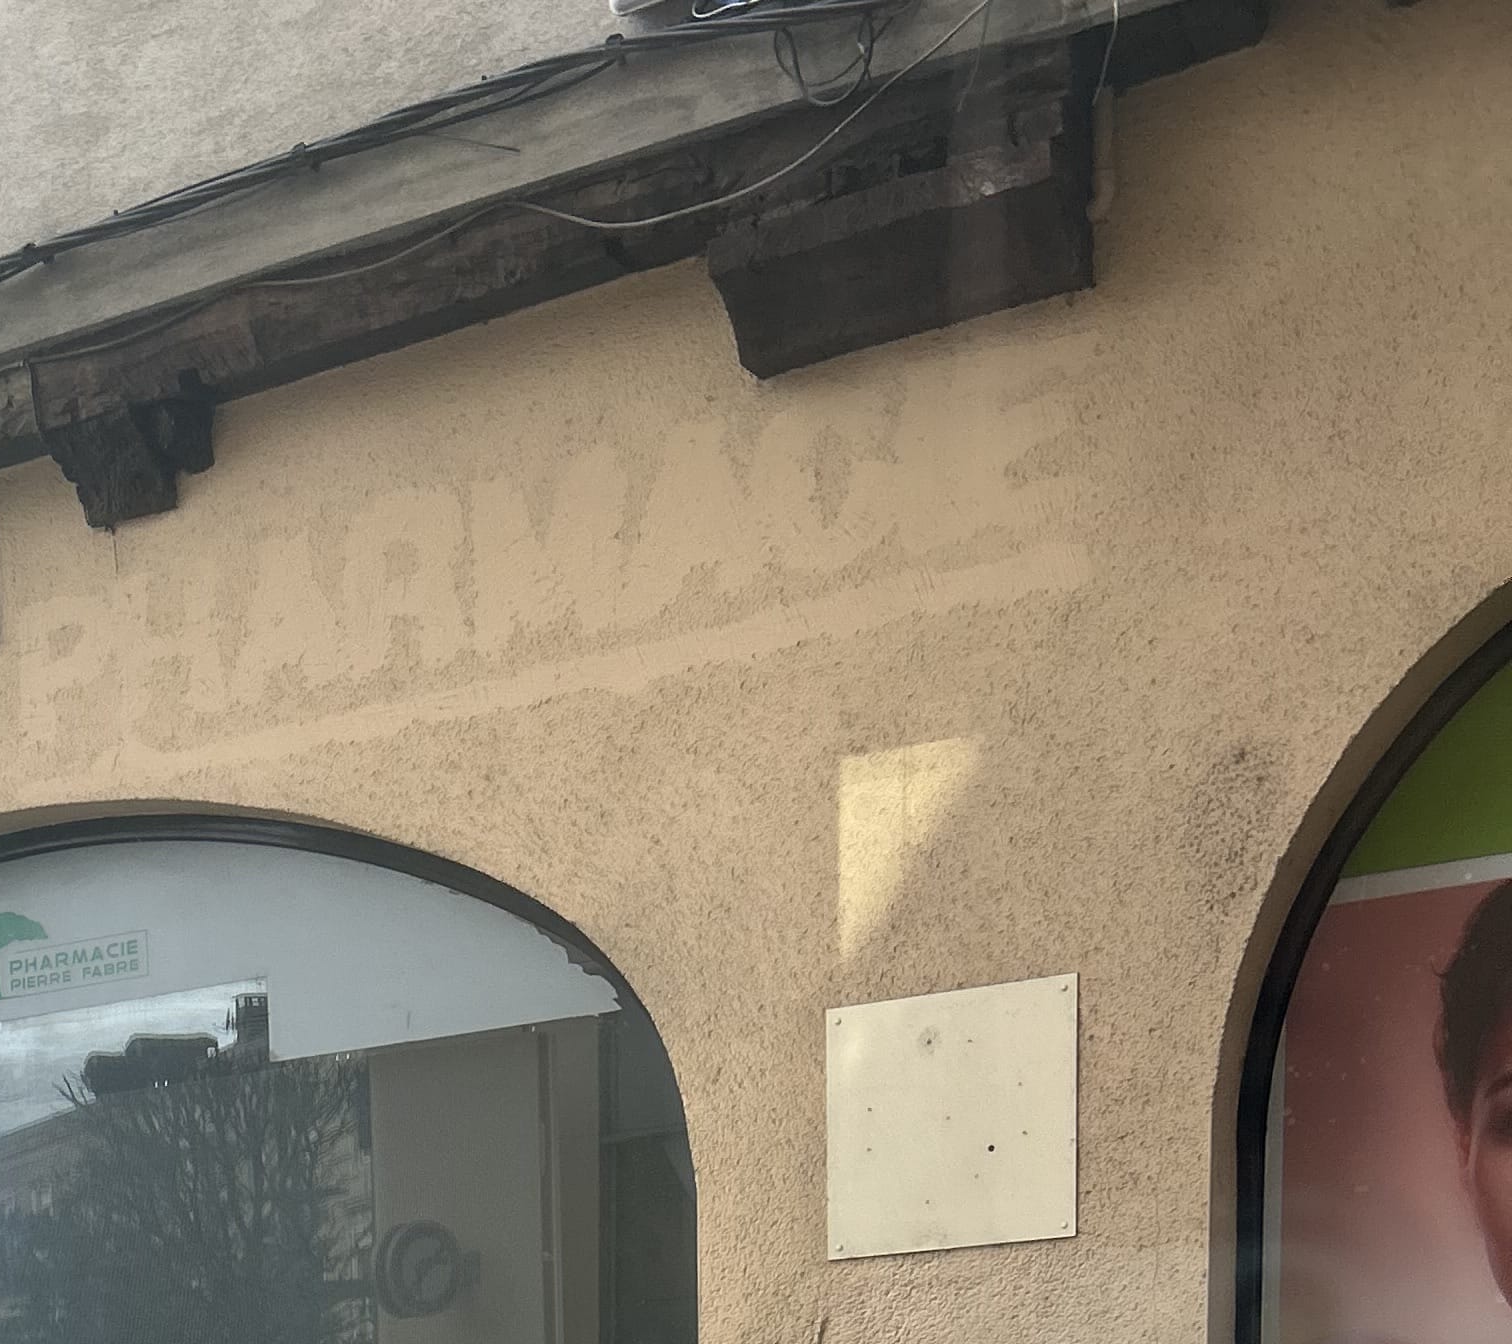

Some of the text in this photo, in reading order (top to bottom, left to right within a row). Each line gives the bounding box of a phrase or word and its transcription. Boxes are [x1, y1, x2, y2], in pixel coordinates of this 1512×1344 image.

[9, 940, 138, 975] PHARMACIE
[10, 971, 72, 992] PIERRE
[82, 958, 139, 980] FABRE
